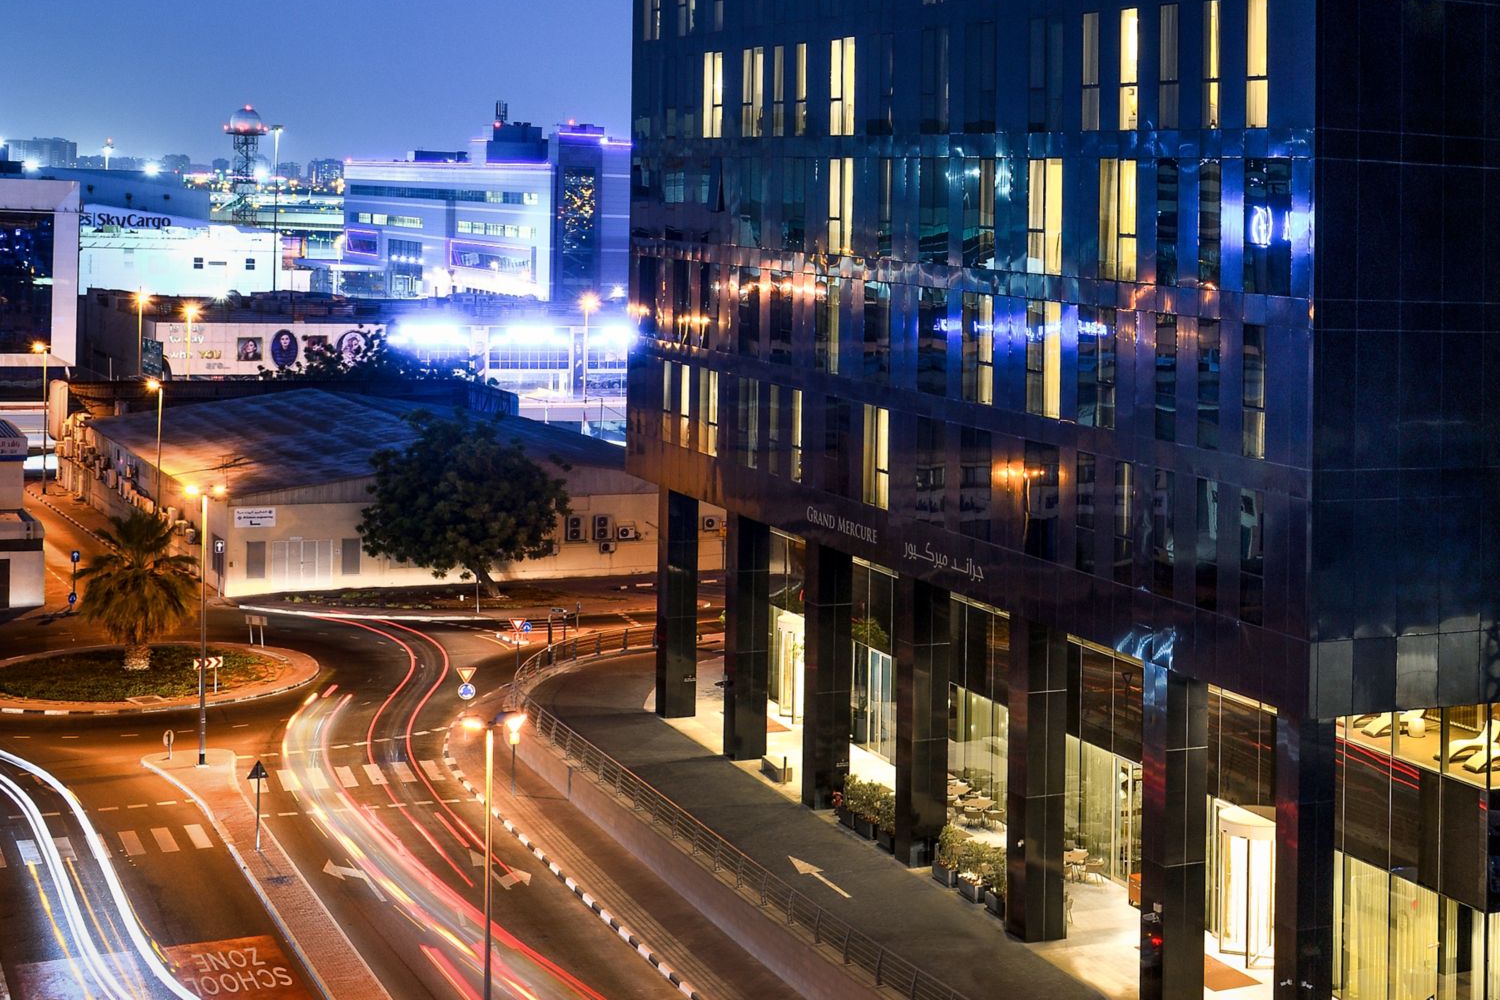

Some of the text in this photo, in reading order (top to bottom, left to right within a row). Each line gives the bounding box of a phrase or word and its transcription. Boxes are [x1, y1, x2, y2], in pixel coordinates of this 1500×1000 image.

[97, 212, 171, 229] SkyCargo
[806, 505, 878, 544] GRAND MERCURE
[191, 947, 266, 973] ZONE
[183, 967, 293, 997] SCHOOL
